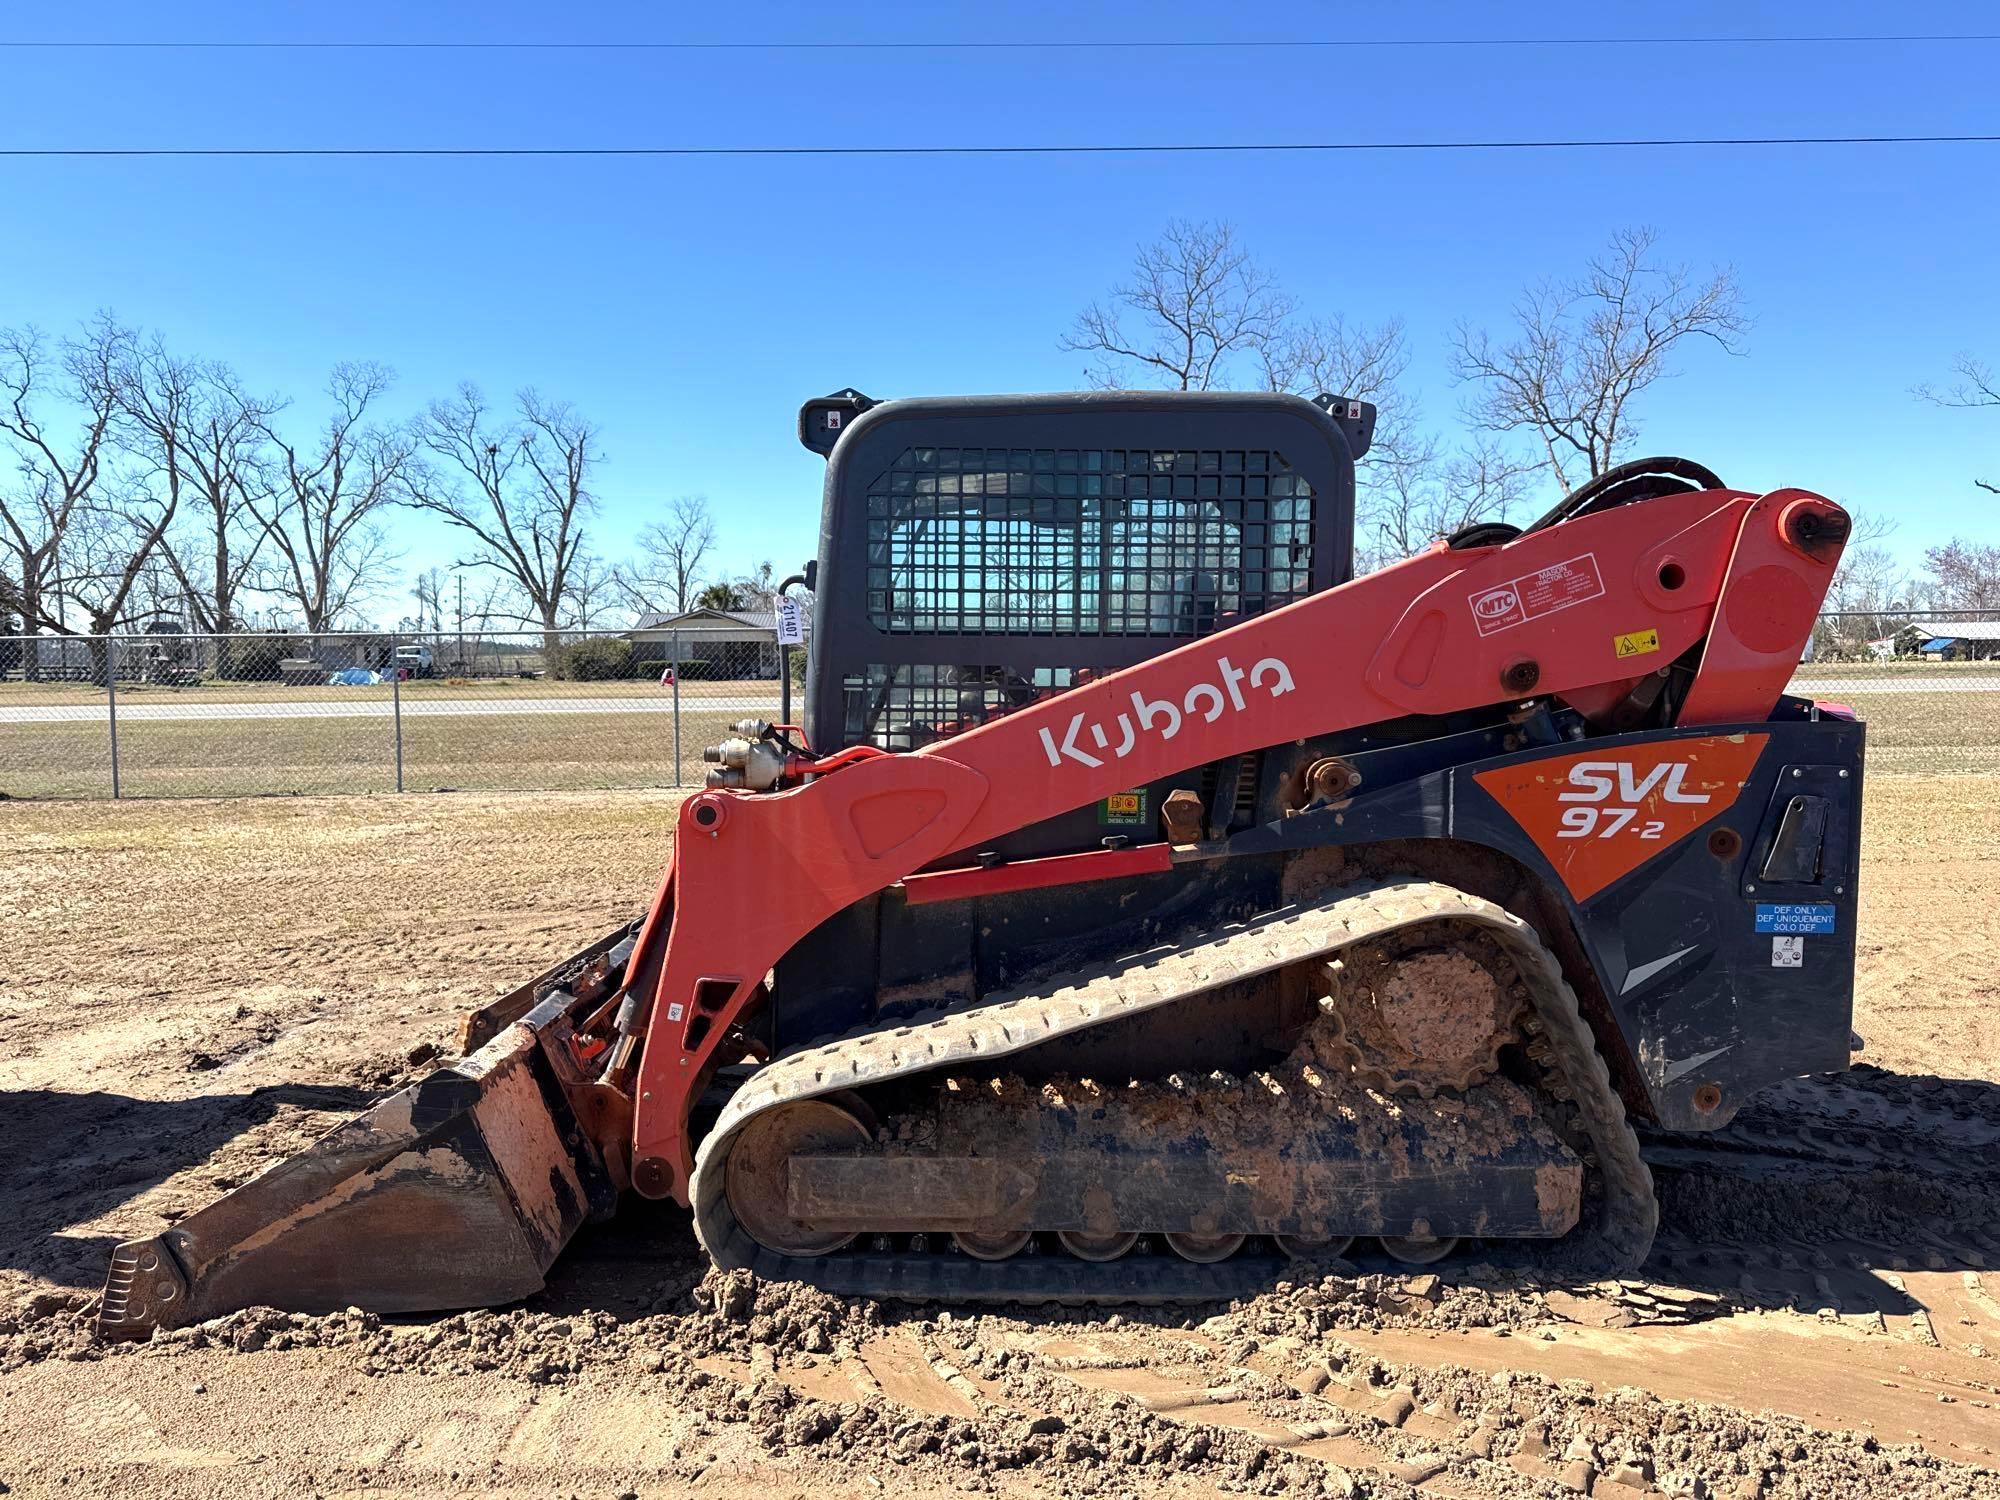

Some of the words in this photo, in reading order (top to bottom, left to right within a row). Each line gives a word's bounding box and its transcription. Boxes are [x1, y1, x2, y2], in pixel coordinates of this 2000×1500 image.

[1535, 572, 1563, 587] TRACTOR
[1538, 565, 1567, 581] MASON
[1480, 593, 1513, 615] MTC
[783, 605, 798, 637] 211407
[1038, 656, 1296, 768] Kubota
[1557, 761, 1711, 803] SVL
[1556, 807, 1665, 839] 97-2
[1757, 914, 1774, 922] DEF
[1776, 915, 1834, 923] UNIQUEMENT
[1774, 906, 1791, 914] DEF
[1794, 906, 1817, 914] ONLY
[1773, 923, 1797, 932] SOLO
[1799, 923, 1816, 932] DEF
